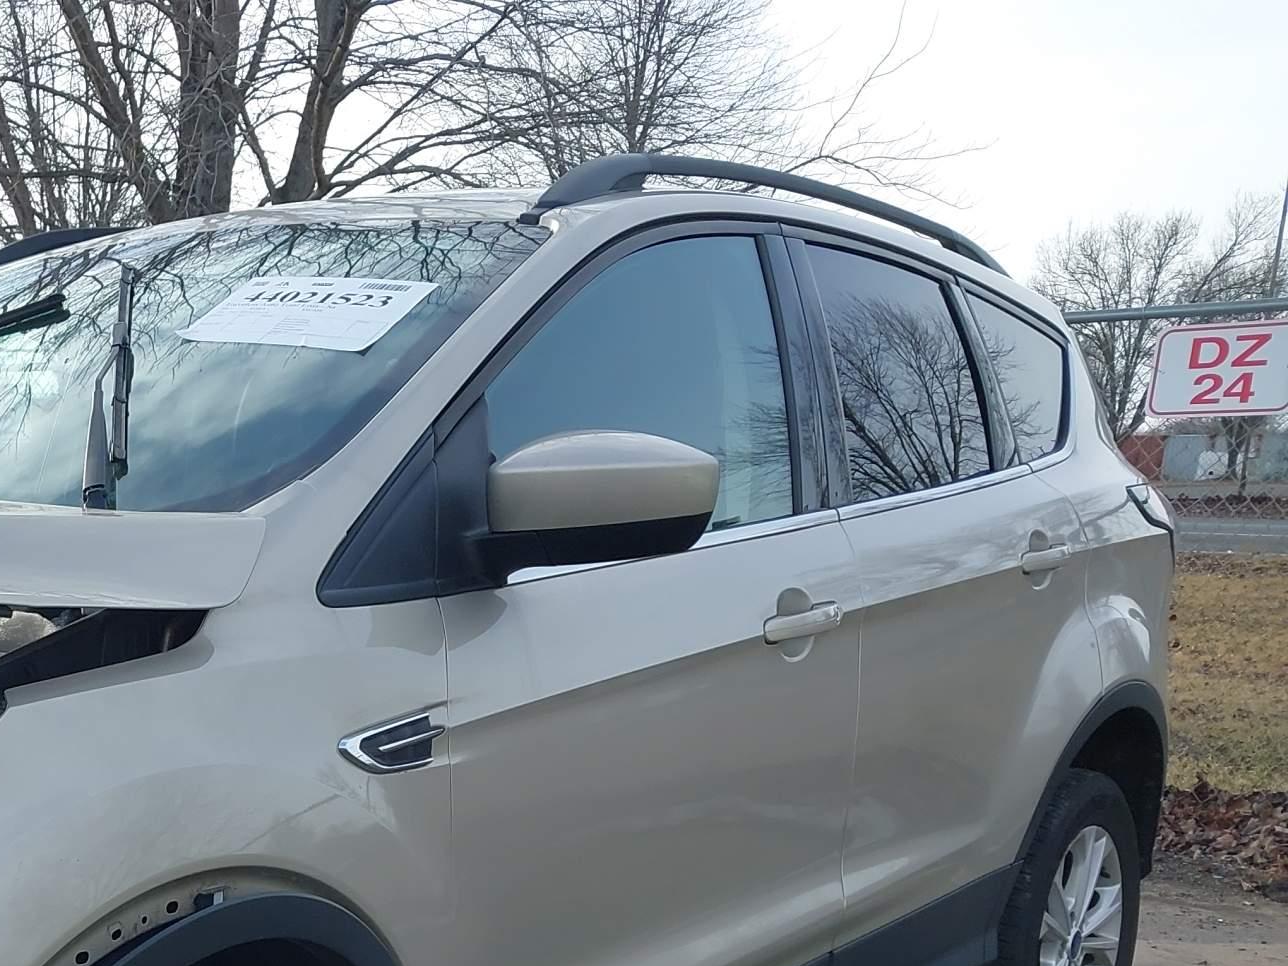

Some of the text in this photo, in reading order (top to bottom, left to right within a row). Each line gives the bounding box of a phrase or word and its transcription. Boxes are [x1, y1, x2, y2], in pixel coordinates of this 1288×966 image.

[244, 290, 394, 308] 44021523
[1188, 333, 1272, 369] DZ
[1190, 372, 1255, 404] 24
